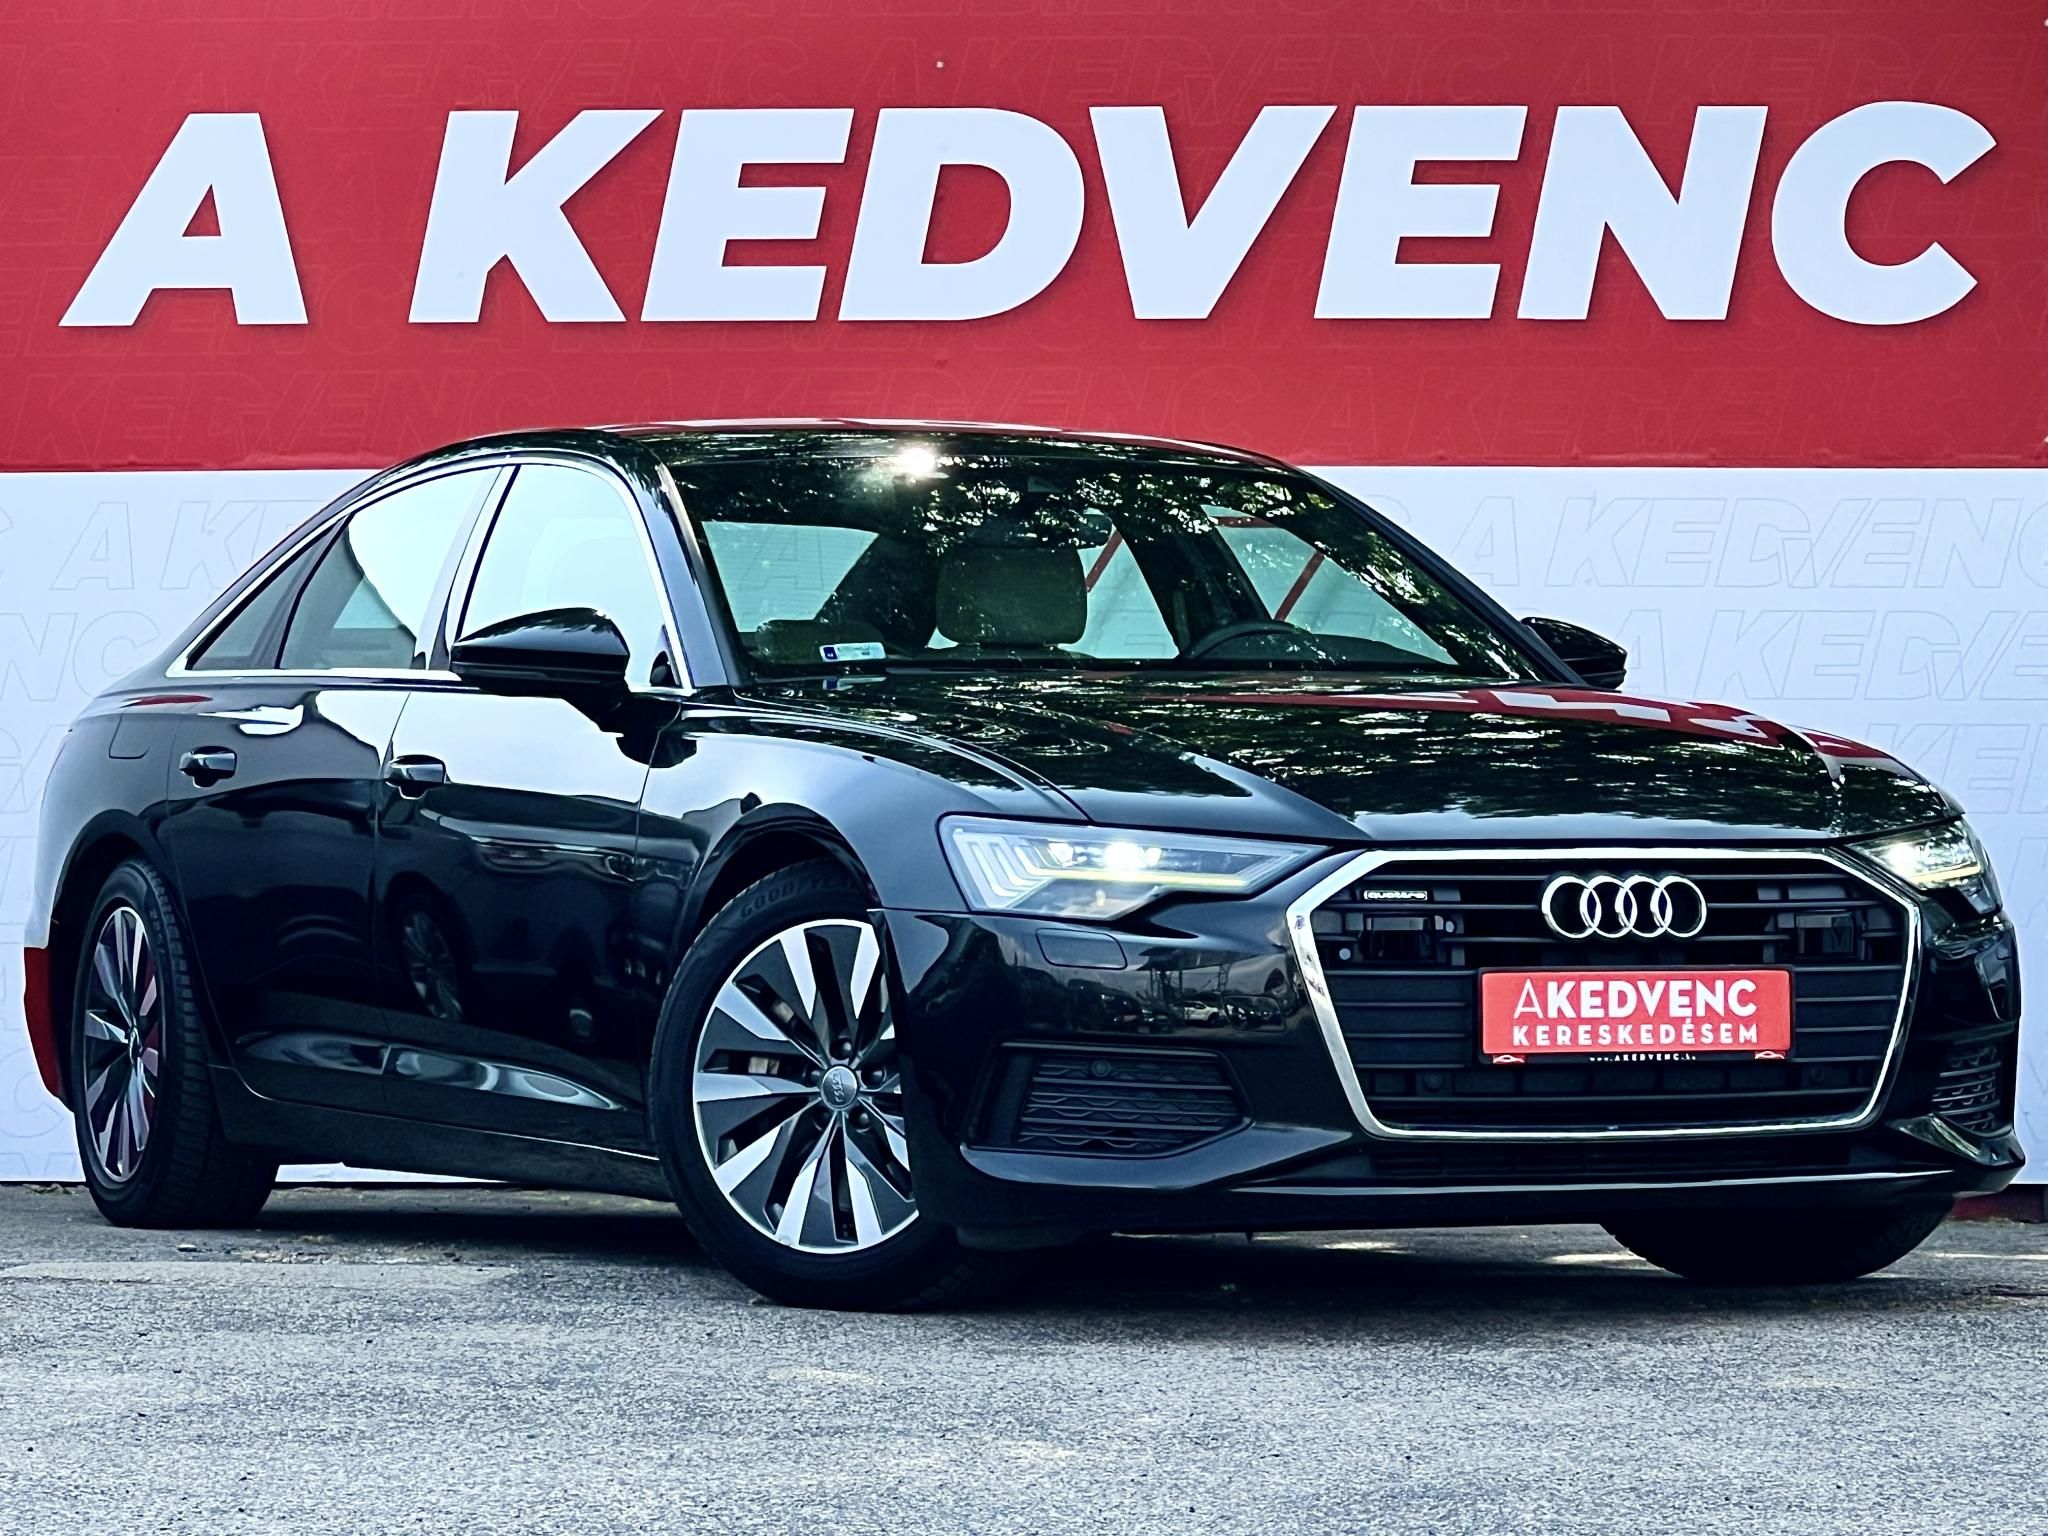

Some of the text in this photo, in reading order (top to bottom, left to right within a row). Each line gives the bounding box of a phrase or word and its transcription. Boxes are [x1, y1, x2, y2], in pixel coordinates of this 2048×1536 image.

[59, 112, 308, 327] A
[408, 100, 1997, 325] KEDVENC
[1513, 1018, 1758, 1047] KERESKEDÉSEM
